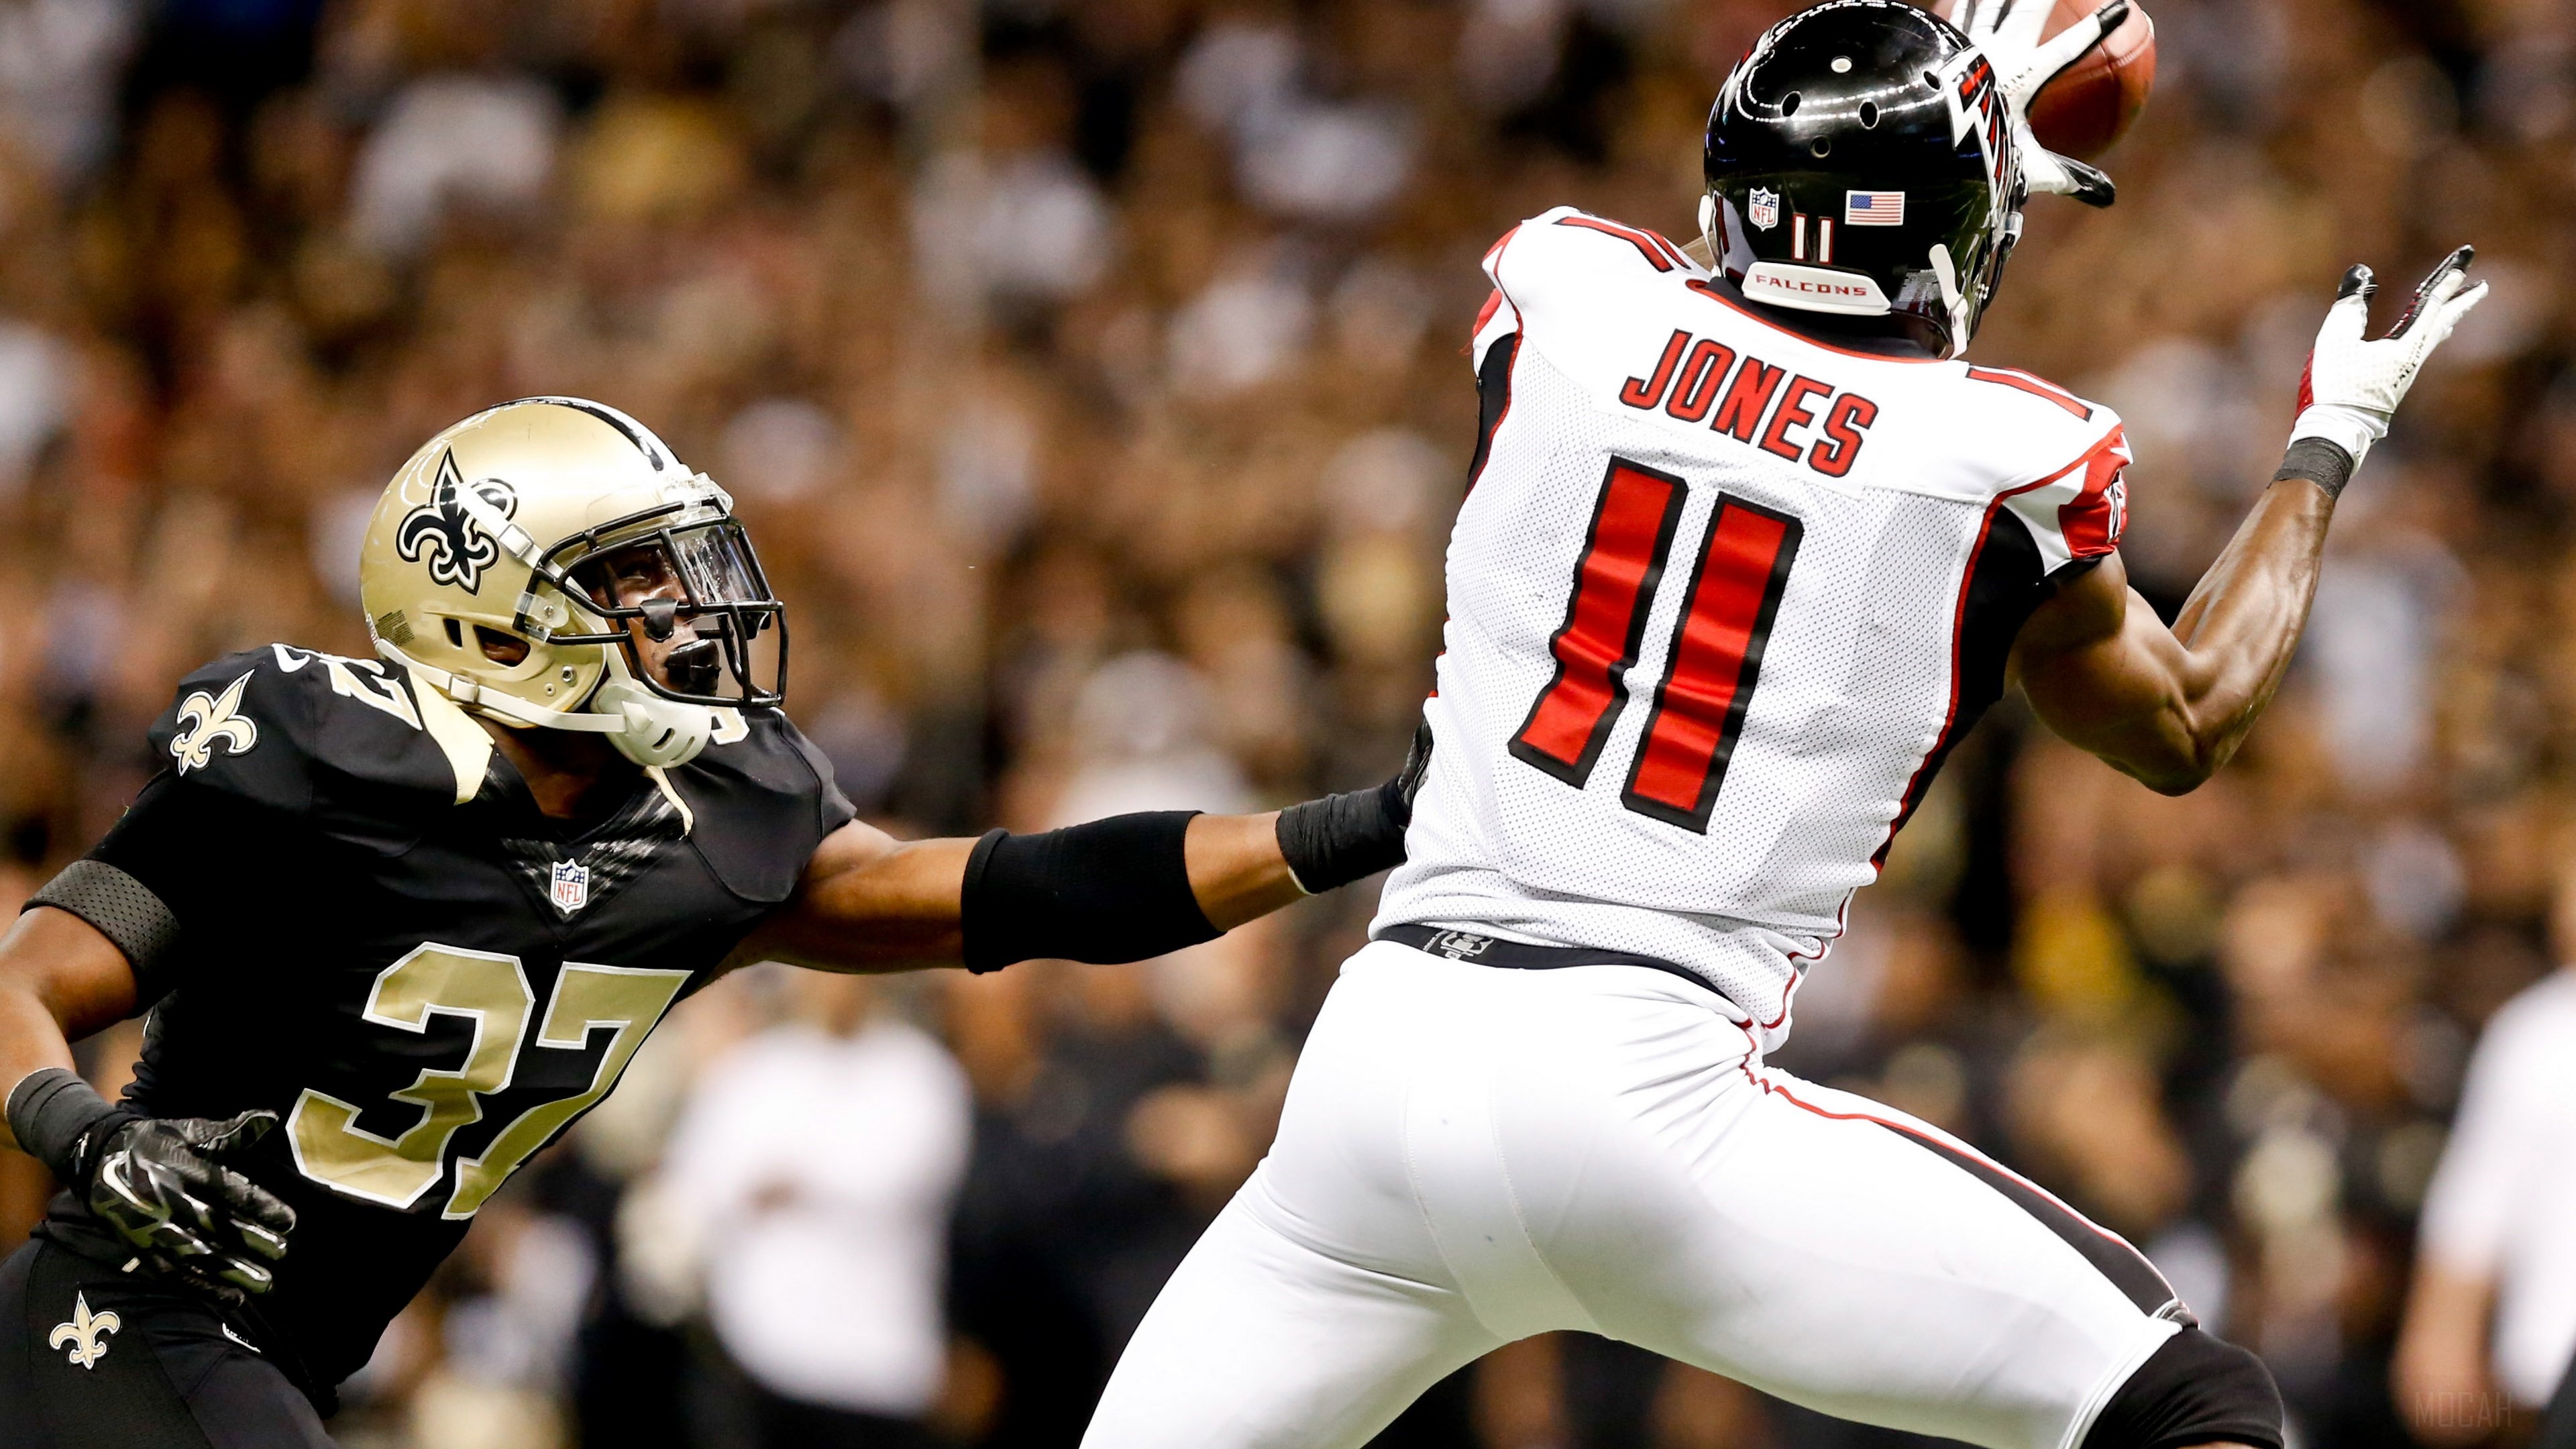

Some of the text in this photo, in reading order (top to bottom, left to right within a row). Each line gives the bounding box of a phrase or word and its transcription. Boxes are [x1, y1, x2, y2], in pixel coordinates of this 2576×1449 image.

[1753, 205, 1774, 223] NFL
[1792, 213, 1834, 265] 11
[1756, 274, 1867, 296] FALCONS
[1619, 328, 1879, 477] JONES
[1508, 453, 1804, 835] 11
[556, 882, 581, 903] NFL
[285, 941, 694, 1221] 37
